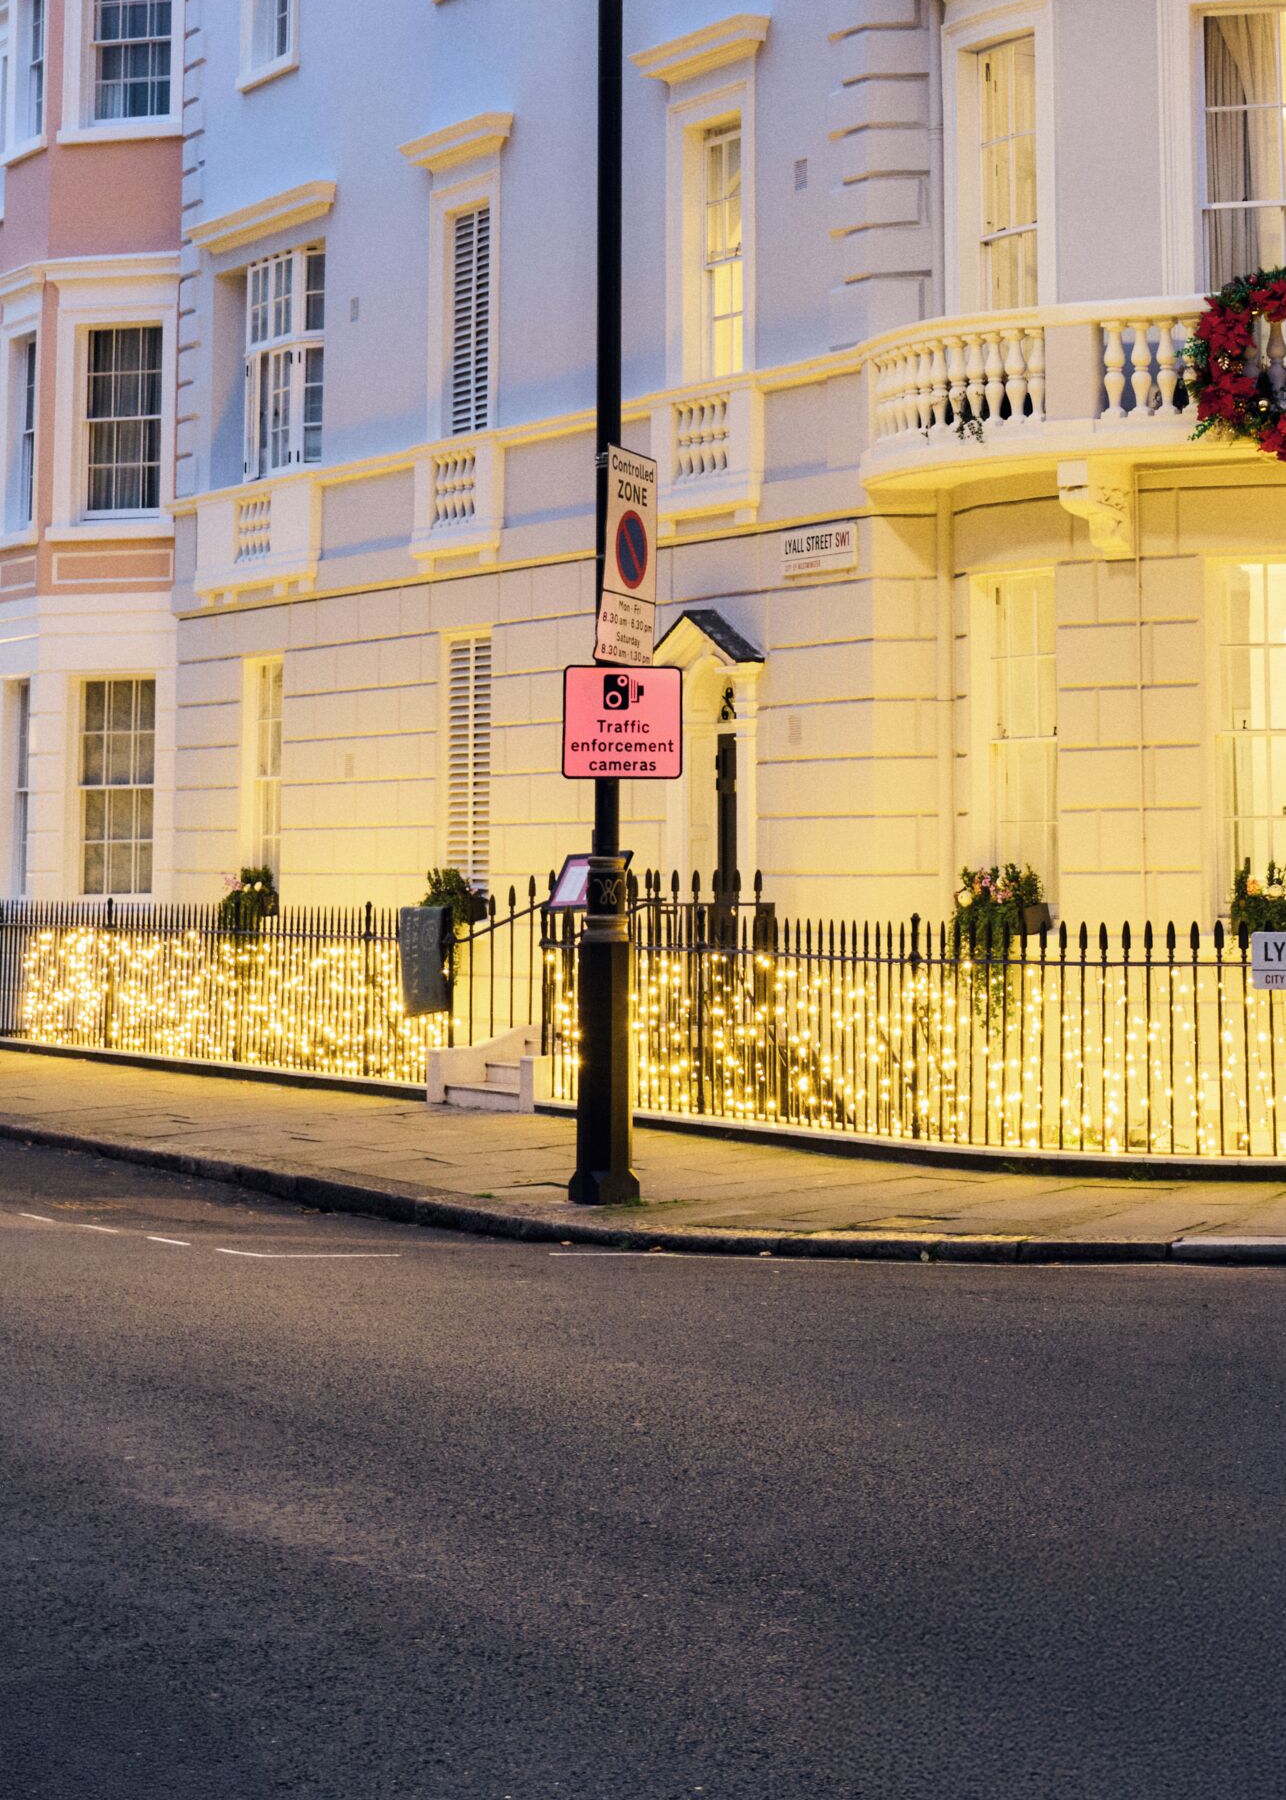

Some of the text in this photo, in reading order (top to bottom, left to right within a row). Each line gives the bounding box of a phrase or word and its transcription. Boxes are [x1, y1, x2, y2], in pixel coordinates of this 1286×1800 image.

[612, 454, 654, 483] Controlled
[618, 479, 647, 507] ZONE
[784, 531, 850, 555] LYALL STREET SW1
[616, 631, 640, 648] Saturday
[597, 720, 650, 733] Traffic
[571, 739, 674, 752] enforcement
[589, 760, 656, 771] cameras
[1265, 974, 1284, 984] CITY
